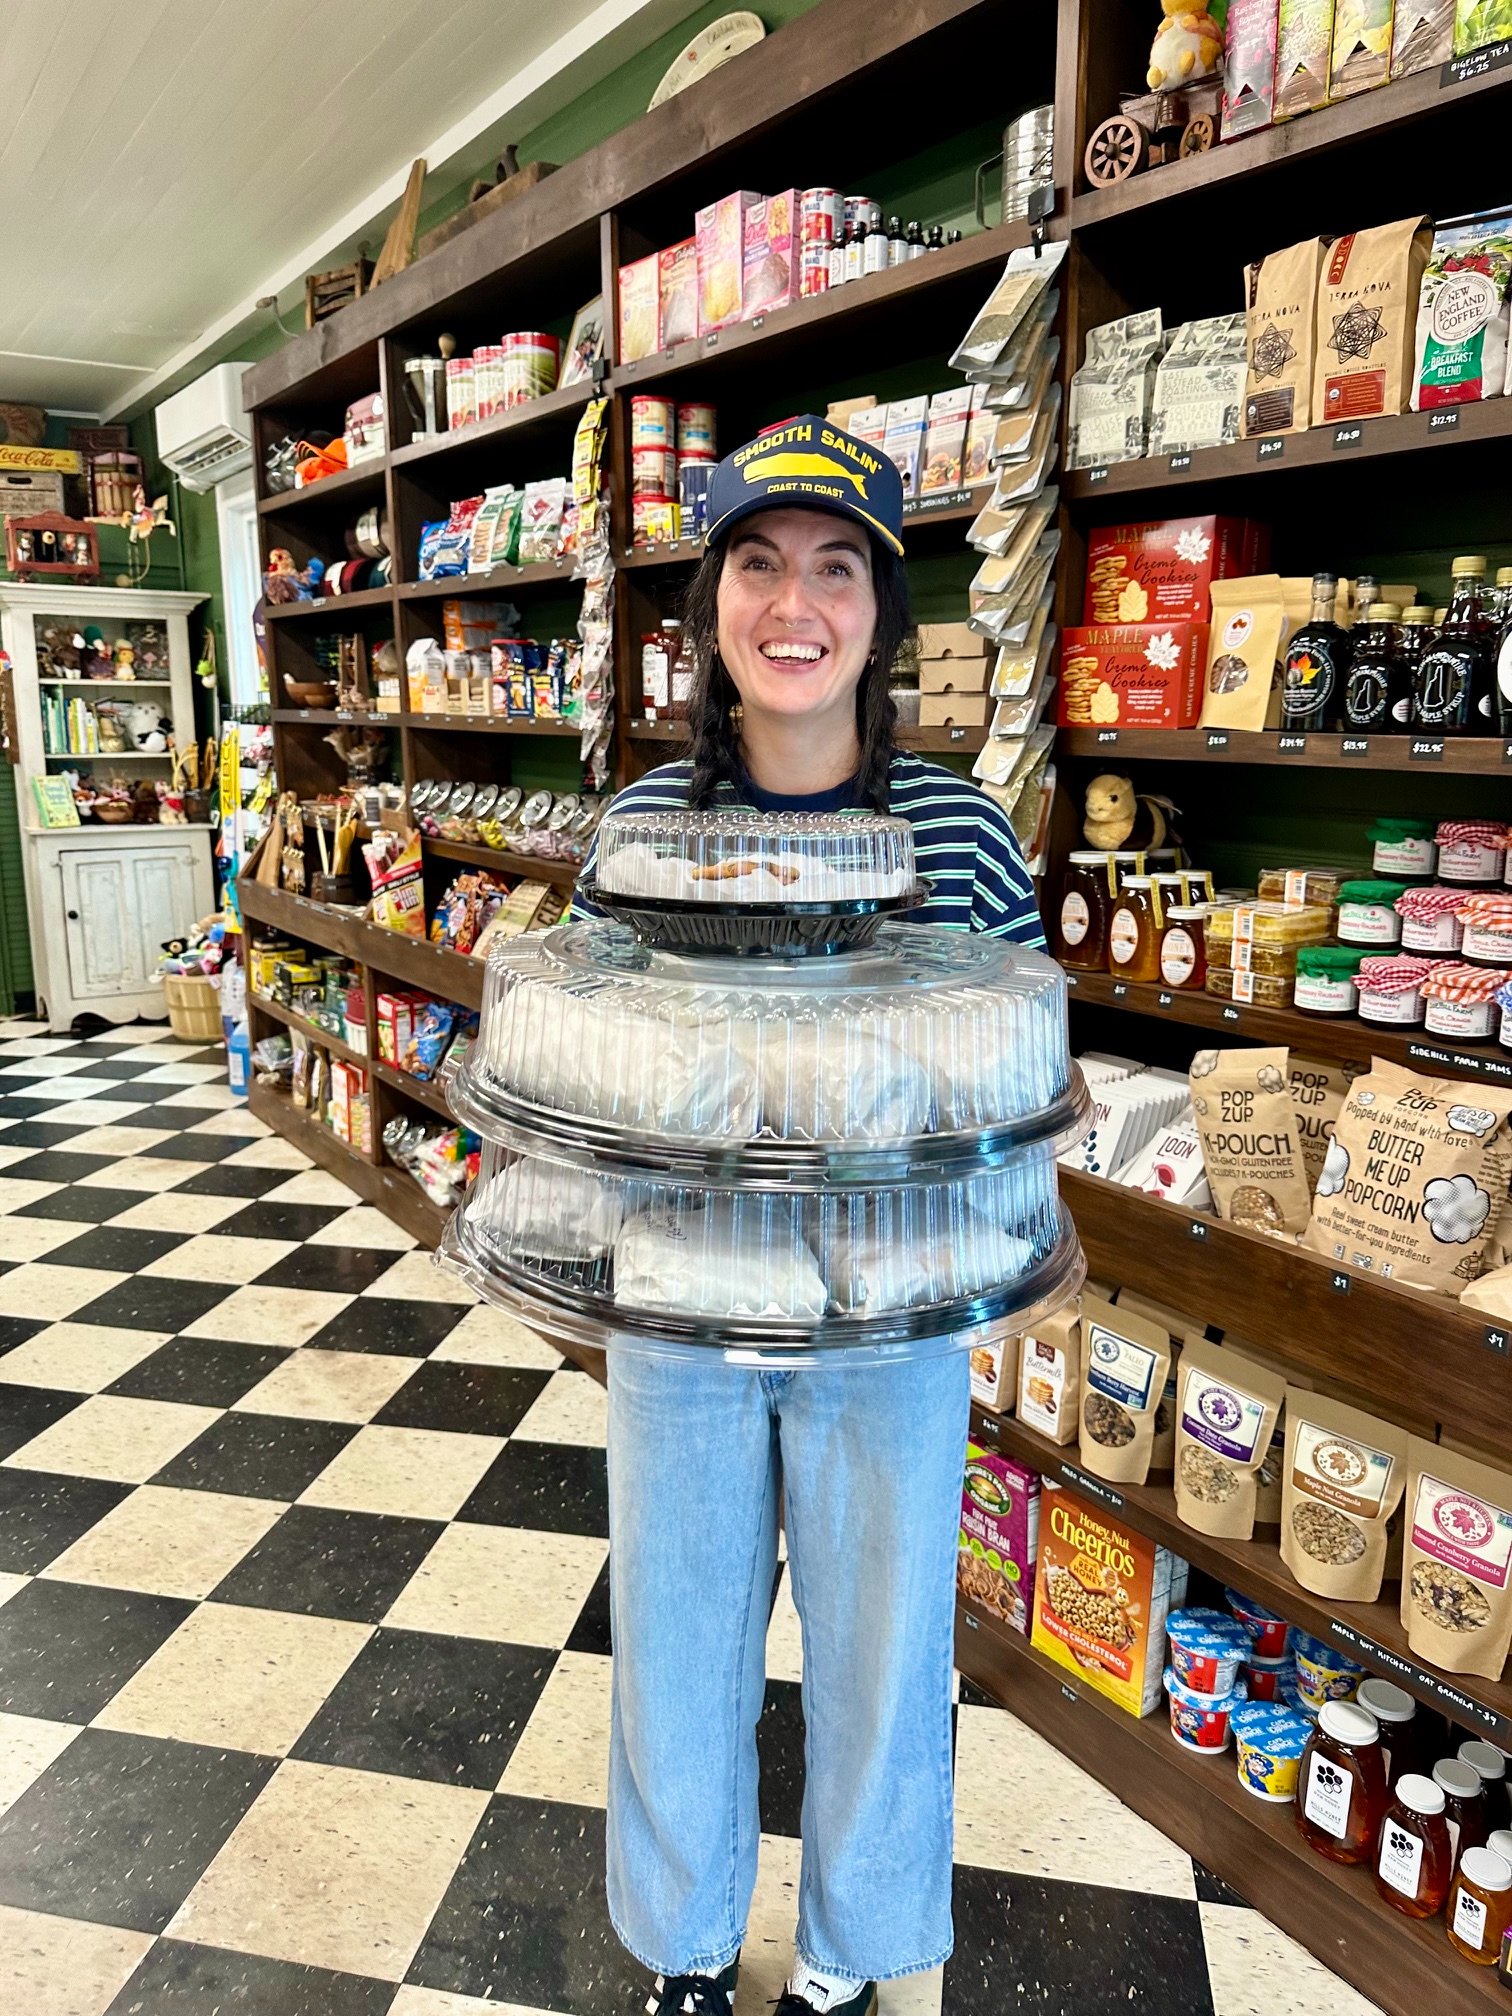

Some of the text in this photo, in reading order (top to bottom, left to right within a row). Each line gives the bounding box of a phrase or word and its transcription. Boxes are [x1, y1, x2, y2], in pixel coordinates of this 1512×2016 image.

[1450, 43, 1510, 71] BIGELOW TEA
[1458, 60, 1490, 80] $6.25
[1363, 281, 1392, 295] NOVA
[1449, 285, 1471, 304] NEW
[1276, 304, 1301, 317] NOVA
[1439, 293, 1485, 322] ENGLAND
[1442, 306, 1482, 331] COFFEE
[1431, 351, 1474, 368] BREAKFAST
[1437, 365, 1462, 378] BLEND
[1430, 415, 1457, 427] $12.95
[1335, 430, 1360, 442] $16.50
[733, 424, 883, 474] SMOOTH SAILIN'
[767, 482, 844, 499] COAST TO COAST
[1114, 525, 1173, 545] MAPLE
[1133, 553, 1178, 571] Creme
[1140, 569, 1200, 585] Cookies
[1086, 628, 1144, 646] MAPLE
[1105, 656, 1148, 673] Creme
[1111, 672, 1170, 688] Cookies
[1185, 695, 1193, 718] MAPLE
[1420, 691, 1465, 719] MAPLE SYRUP
[1342, 740, 1368, 751] $13.95
[1412, 742, 1444, 753] $22.95
[221, 735, 232, 811] ZEBCO
[1410, 1045, 1511, 1075] SIDEHILL FARM JAMS
[1290, 1071, 1329, 1089] POP
[1220, 1090, 1254, 1106] POP
[1289, 1086, 1326, 1106] ZUP
[1397, 1094, 1438, 1112] ZUP
[1221, 1107, 1253, 1123] ZUP
[1345, 1100, 1379, 1122] popped
[1379, 1110, 1394, 1125] by
[1392, 1116, 1420, 1134] hand
[1419, 1125, 1442, 1139] with
[1156, 1136, 1197, 1159] LOON
[1203, 1132, 1292, 1156] K-POUCH
[1367, 1129, 1425, 1167] BUTTER
[1241, 1157, 1270, 1167] GLUTEN
[1271, 1157, 1293, 1166] FREE
[1364, 1156, 1411, 1188] ME UP
[1241, 1168, 1295, 1180] K-POUCHES
[1343, 1178, 1421, 1224] POPCORN
[1191, 1223, 1206, 1237] $9
[1331, 1206, 1420, 1248] Real sweet cream butter
[1316, 1215, 1432, 1265] with better-for-you ingredients
[1333, 1275, 1347, 1289] $7
[1488, 1332, 1504, 1348] $7
[1025, 1356, 1063, 1381] Buttermilk
[1218, 1435, 1242, 1452] Granola
[1304, 1476, 1322, 1490] Maple
[1323, 1486, 1334, 1496] Nut
[1335, 1490, 1362, 1507] Granola
[987, 1527, 1011, 1552] BRAN
[1079, 1512, 1131, 1551] Honey Nut
[1050, 1507, 1135, 1578] Cheerios
[1414, 1528, 1436, 1546] Almond
[1437, 1541, 1470, 1565] Cranberry
[1471, 1558, 1501, 1577] Granola
[1006, 1562, 1018, 1575] NO
[1074, 1564, 1103, 1587] HONEY
[1078, 1560, 1099, 1576] REAL
[1042, 1612, 1127, 1671] LOWER CHOLESTEROL
[1331, 1622, 1356, 1642] MAPLE
[1359, 1639, 1375, 1653] NUT
[1377, 1650, 1412, 1674] KITCHEN
[1418, 1674, 1436, 1688] OAT
[1437, 1685, 1475, 1711] GRANOLA
